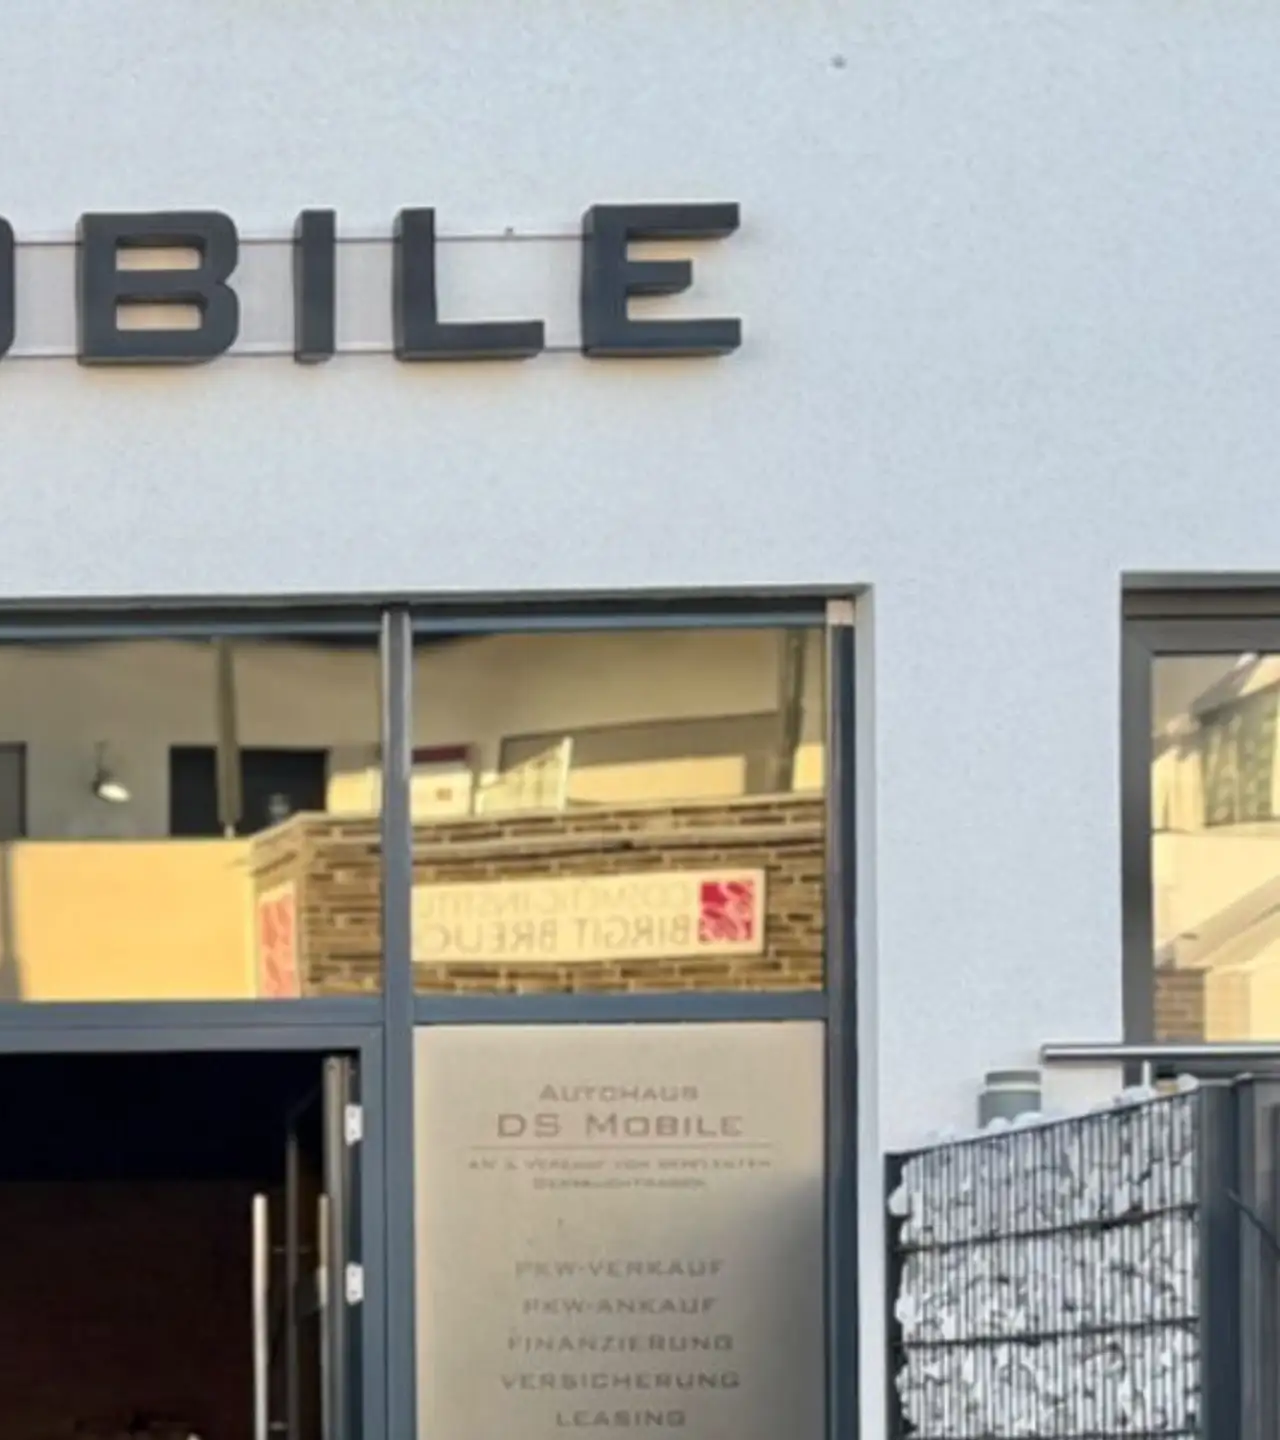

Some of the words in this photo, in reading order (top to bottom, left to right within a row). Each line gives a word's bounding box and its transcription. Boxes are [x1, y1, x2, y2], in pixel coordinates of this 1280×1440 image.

[539, 1084, 700, 1103] AUTOHAUS
[497, 1113, 562, 1139] DS
[585, 1112, 744, 1138] MOBILE
[515, 1259, 725, 1279] PKW-VERKAUF
[522, 1297, 719, 1316] PKW-ANKAUF
[507, 1334, 734, 1353] FINANZIERUNG
[500, 1371, 741, 1391] VERSICHERUNG
[555, 1408, 687, 1429] LEASING
